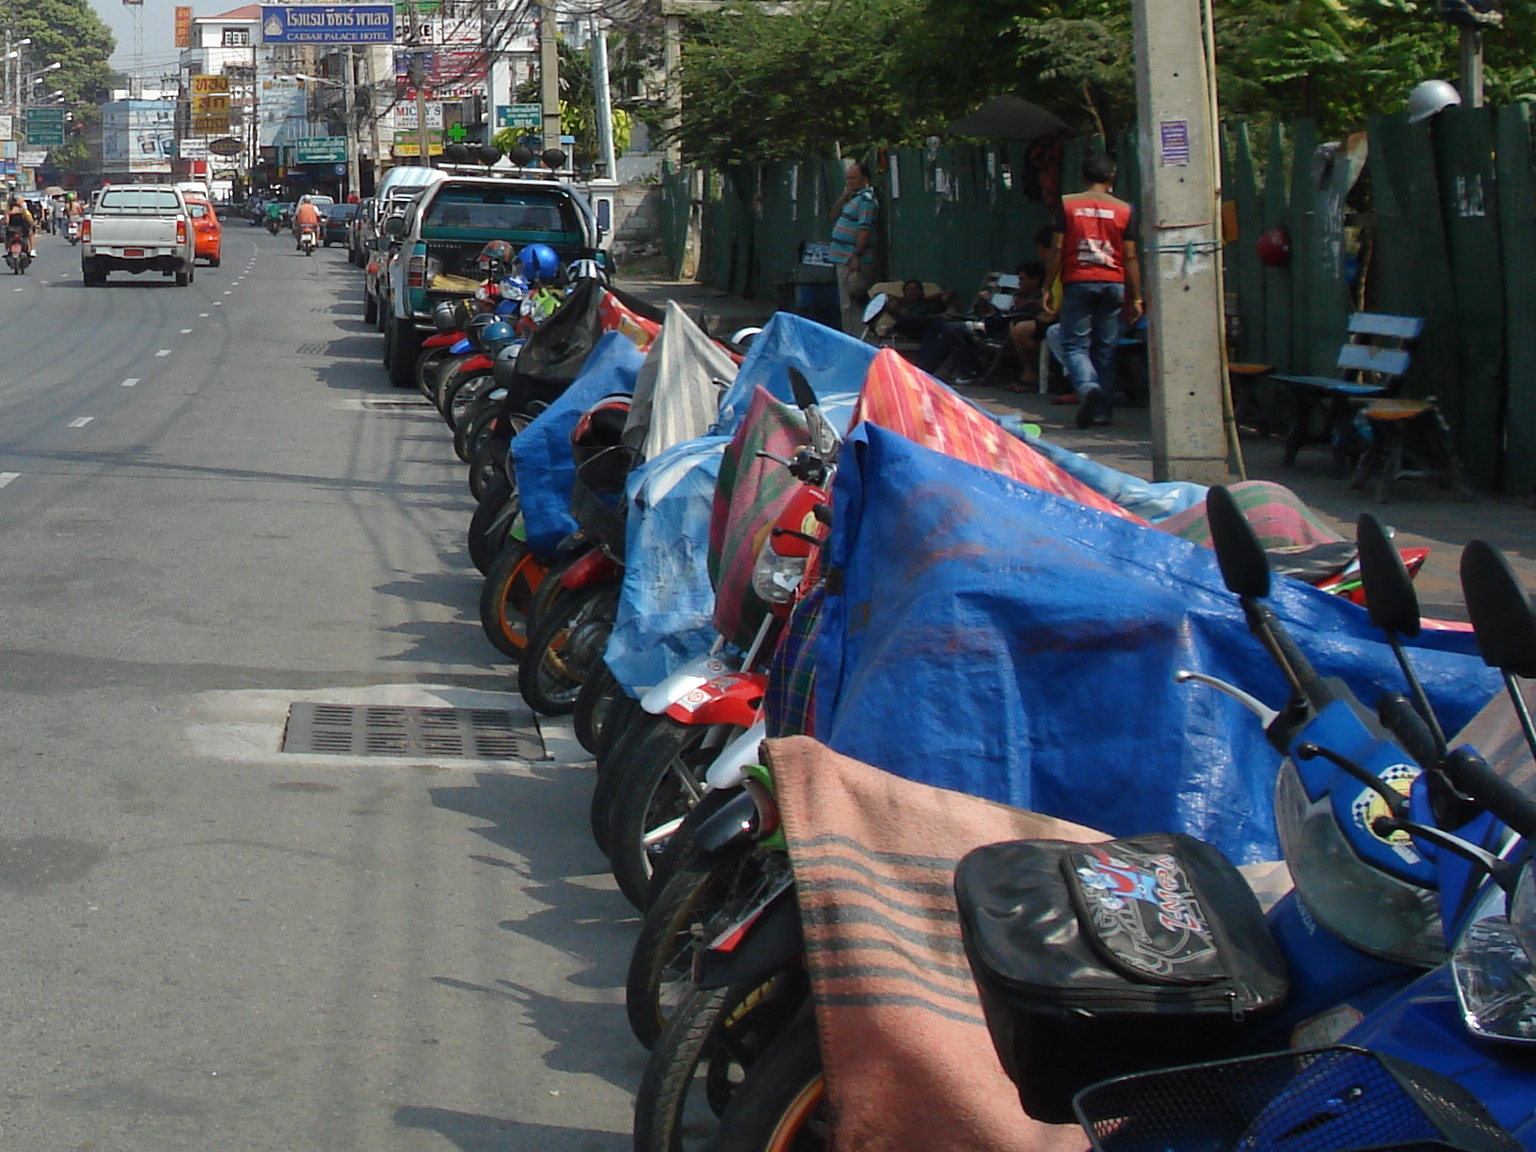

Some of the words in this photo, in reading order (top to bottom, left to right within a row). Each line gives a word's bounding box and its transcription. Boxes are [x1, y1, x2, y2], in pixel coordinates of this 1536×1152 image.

[285, 7, 325, 27] โรงแรม
[286, 32, 323, 42] CAESAR
[324, 32, 357, 42] PALACE
[360, 31, 389, 41] HOTEL
